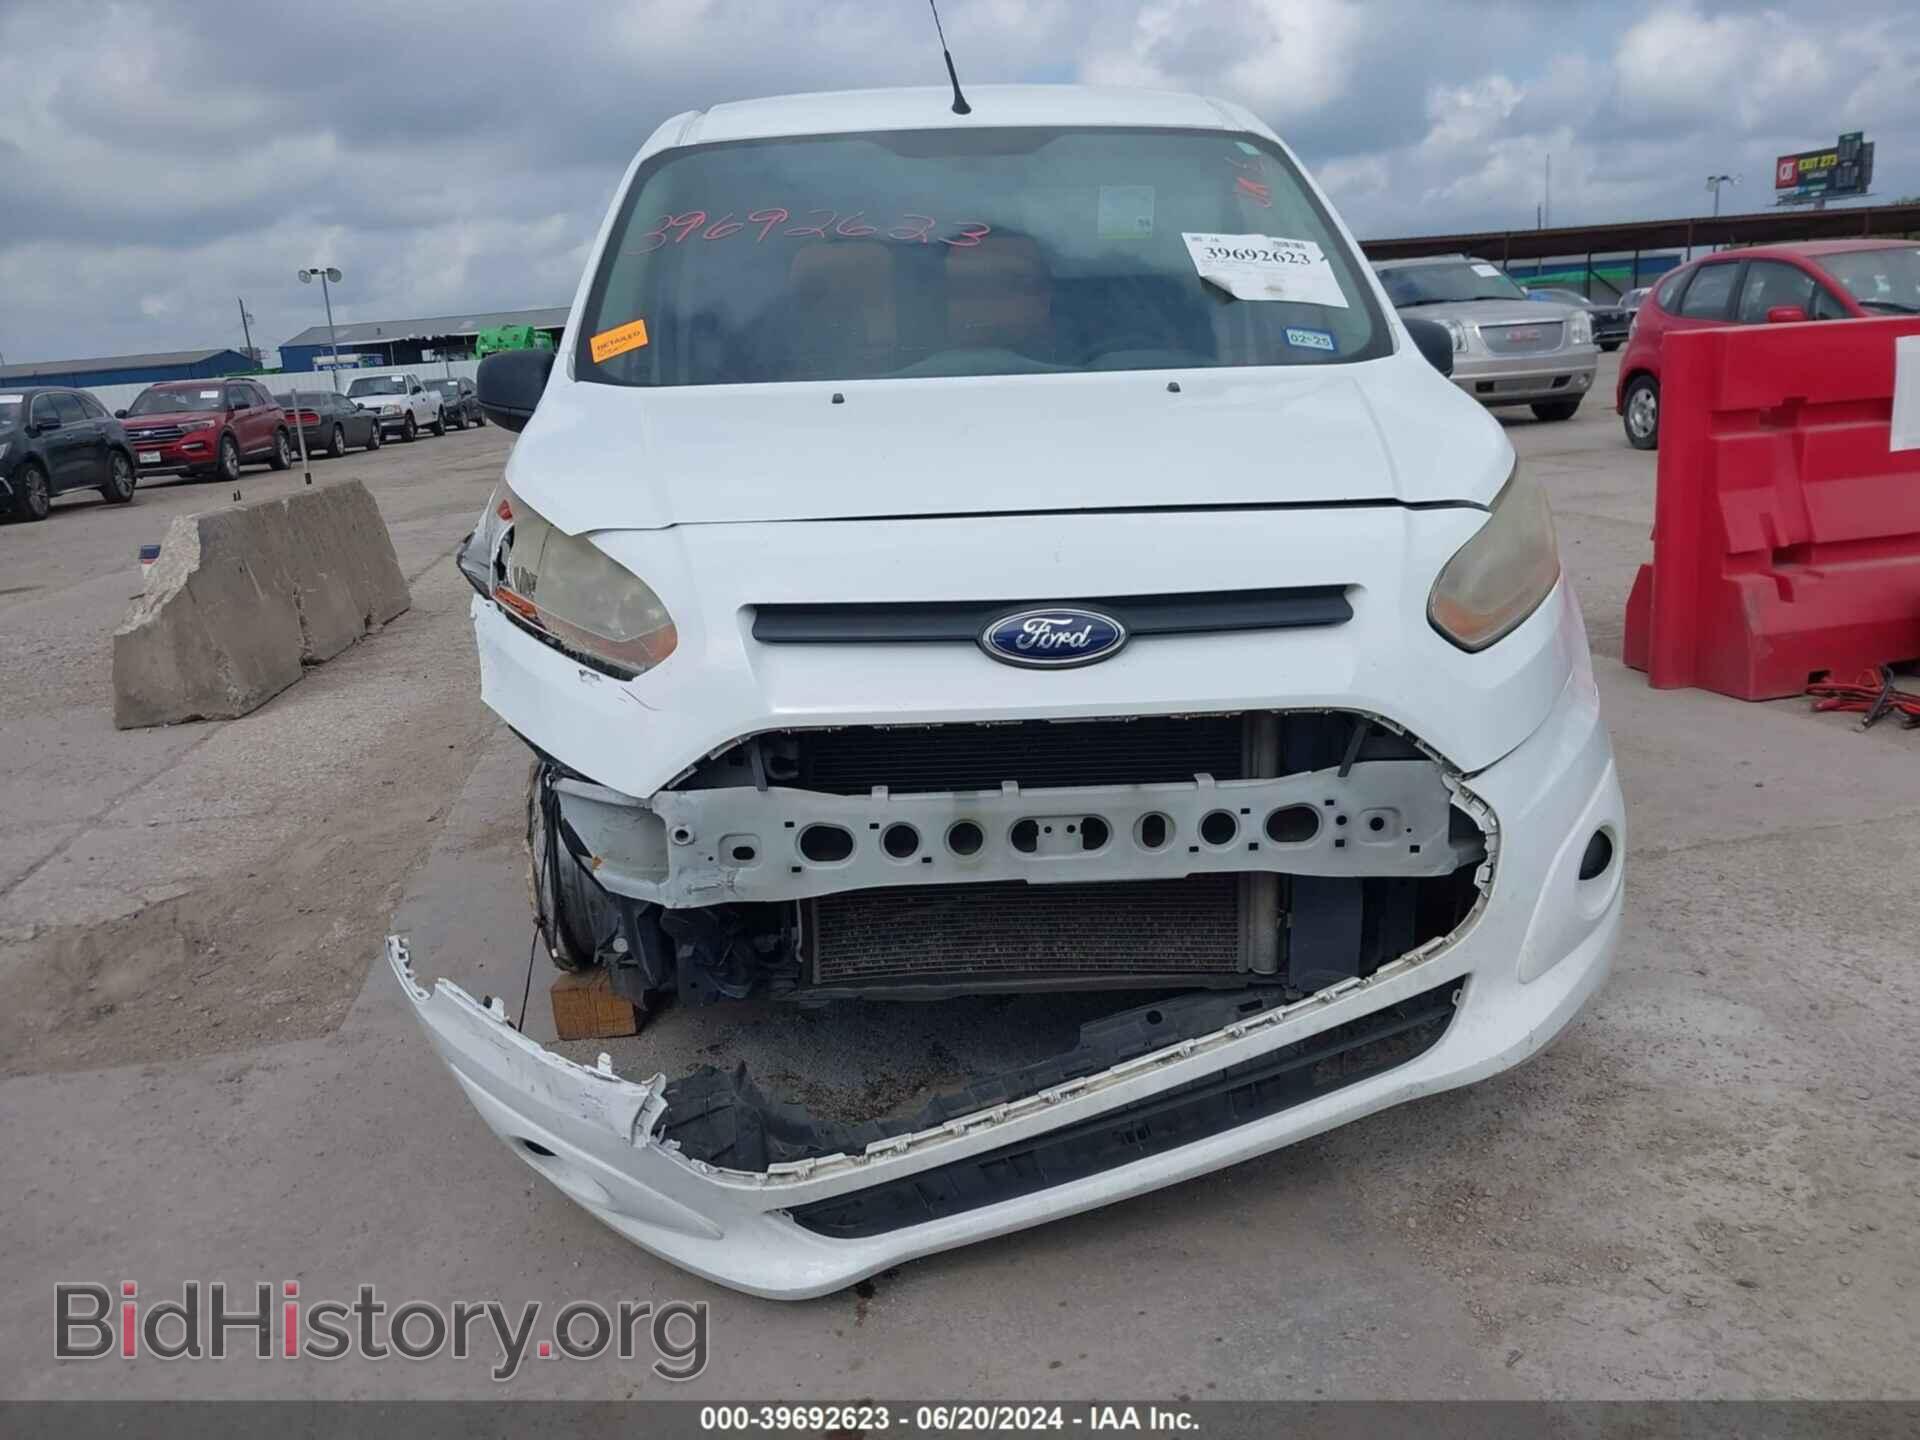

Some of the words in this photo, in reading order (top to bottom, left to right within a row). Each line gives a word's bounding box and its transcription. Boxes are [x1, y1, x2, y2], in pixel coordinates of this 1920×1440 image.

[636, 208, 991, 255] 39692623
[1205, 247, 1311, 265] 39692623
[1016, 618, 1093, 649] Ford
